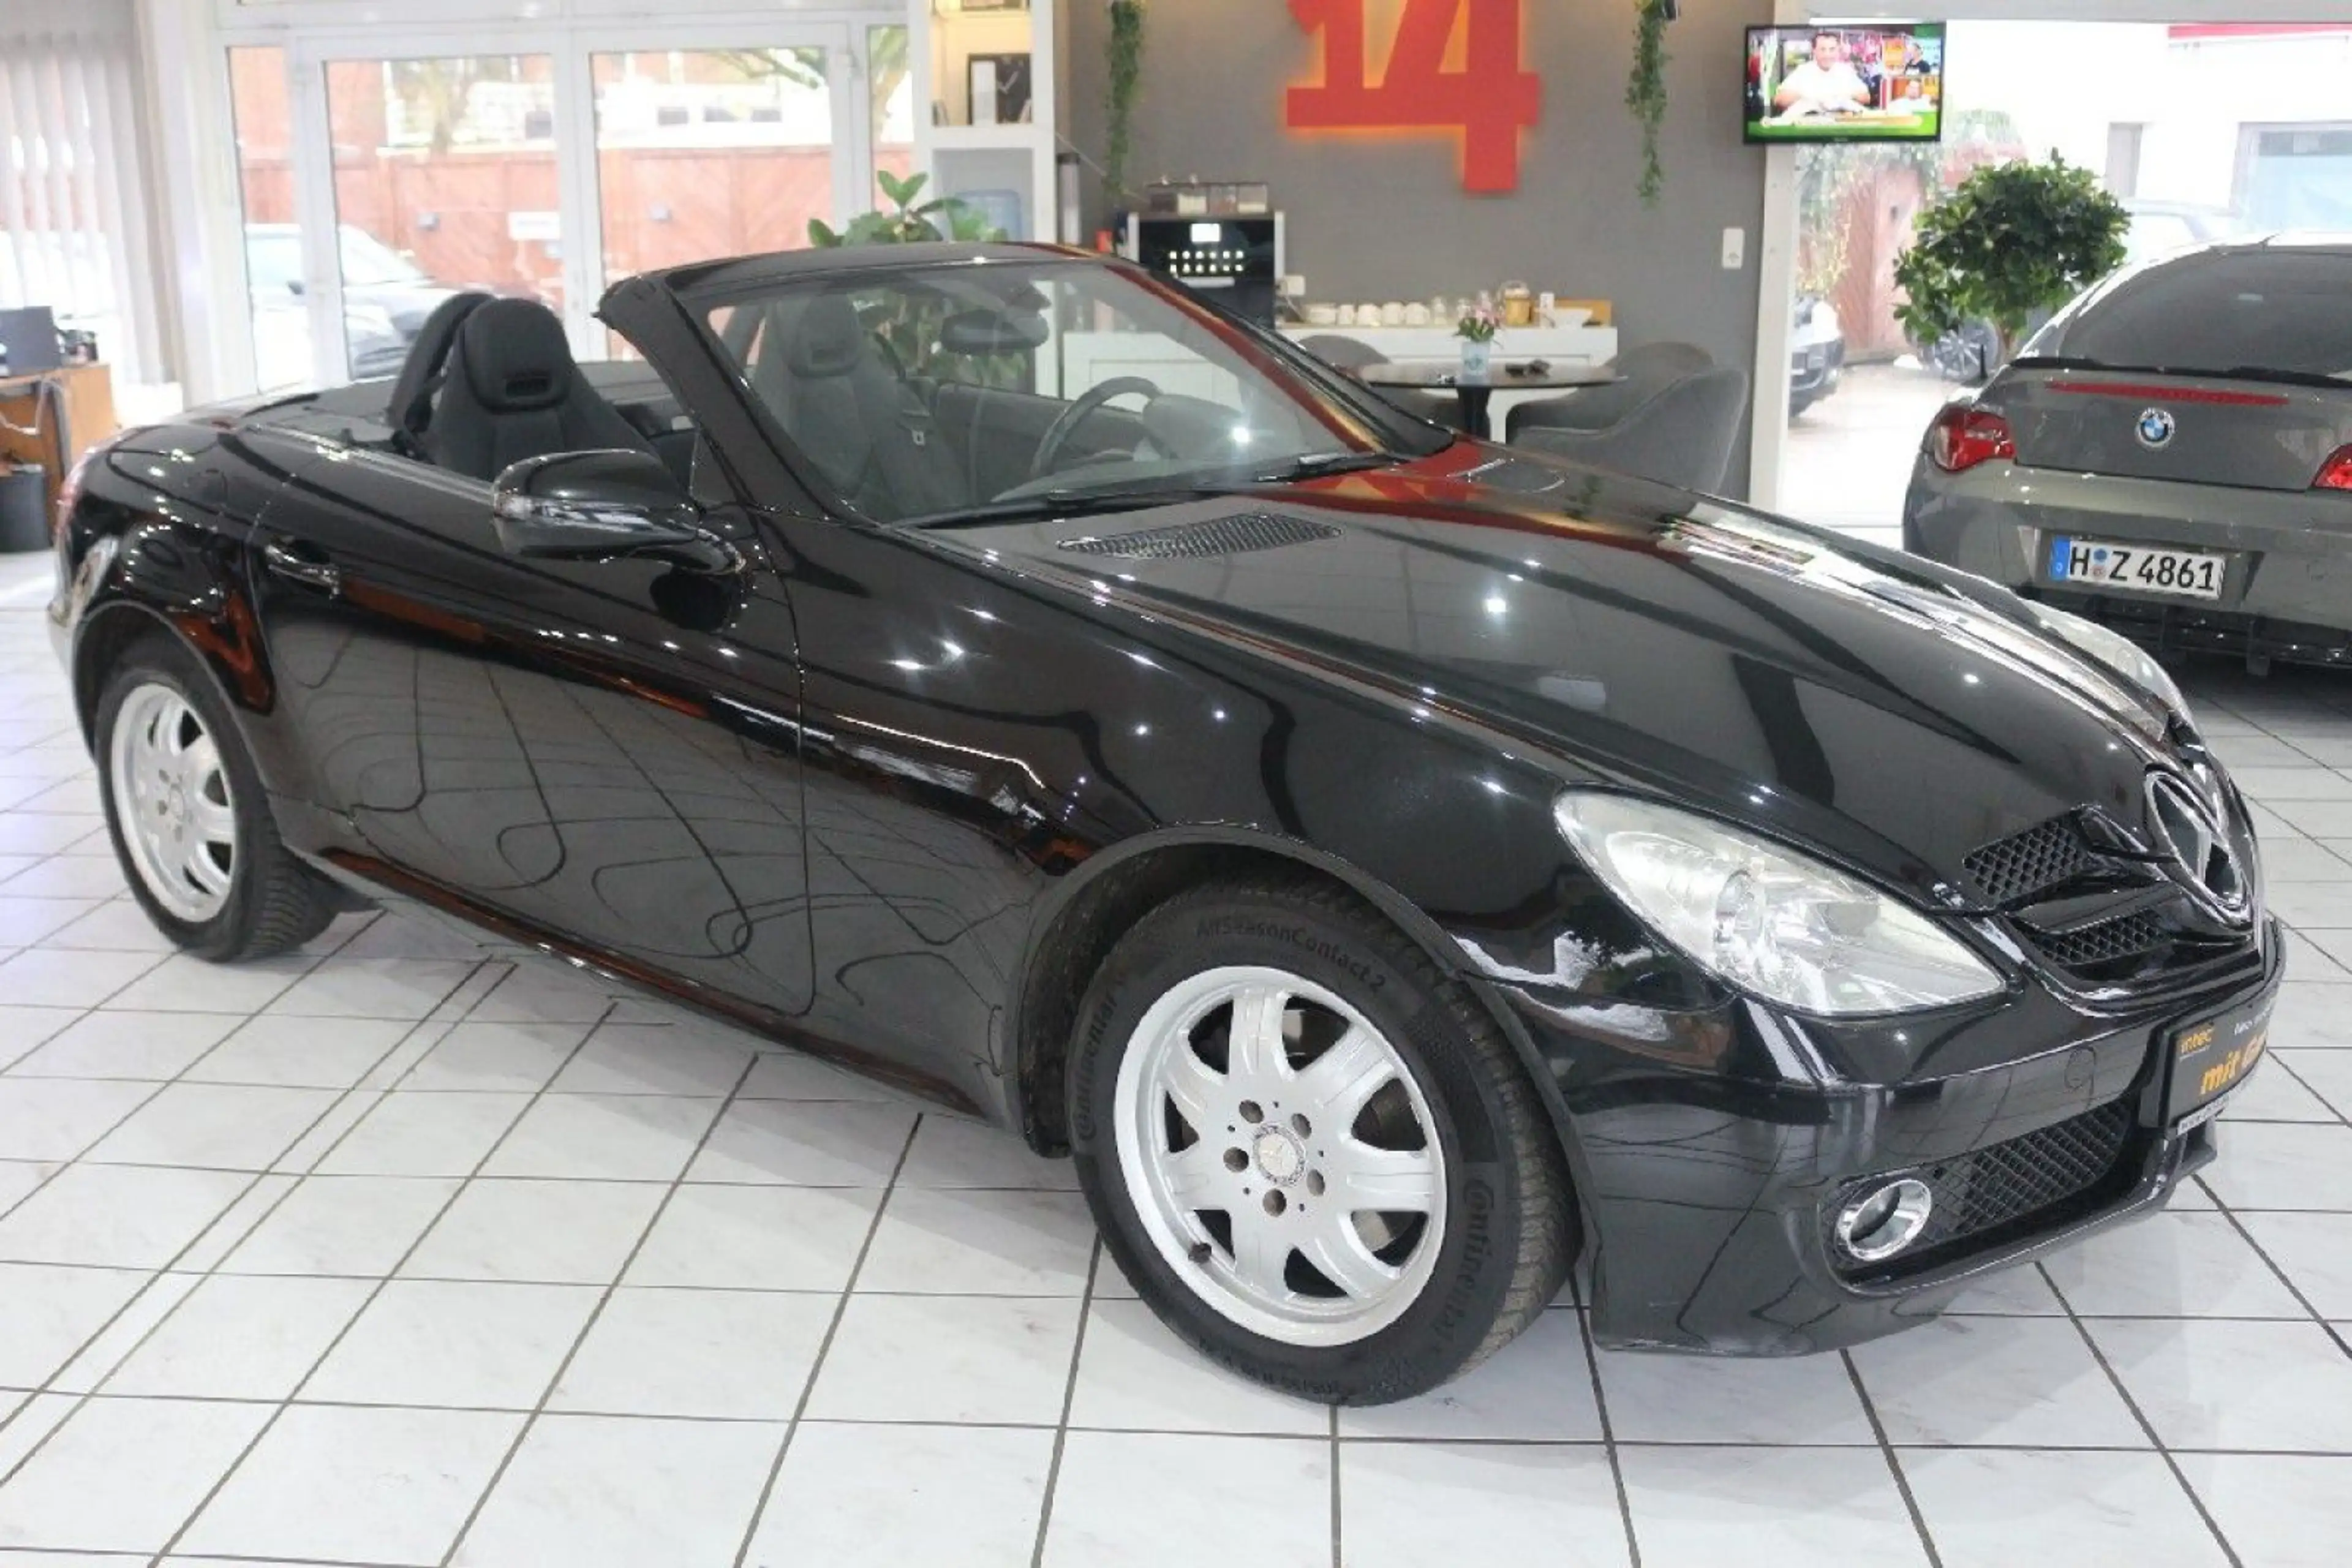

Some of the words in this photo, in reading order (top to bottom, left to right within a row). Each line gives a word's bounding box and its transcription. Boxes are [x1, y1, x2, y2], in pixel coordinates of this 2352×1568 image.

[1285, 0, 1540, 190] 14
[2069, 546, 2090, 576] H
[2109, 550, 2132, 581] Z
[2136, 554, 2215, 592] 4861
